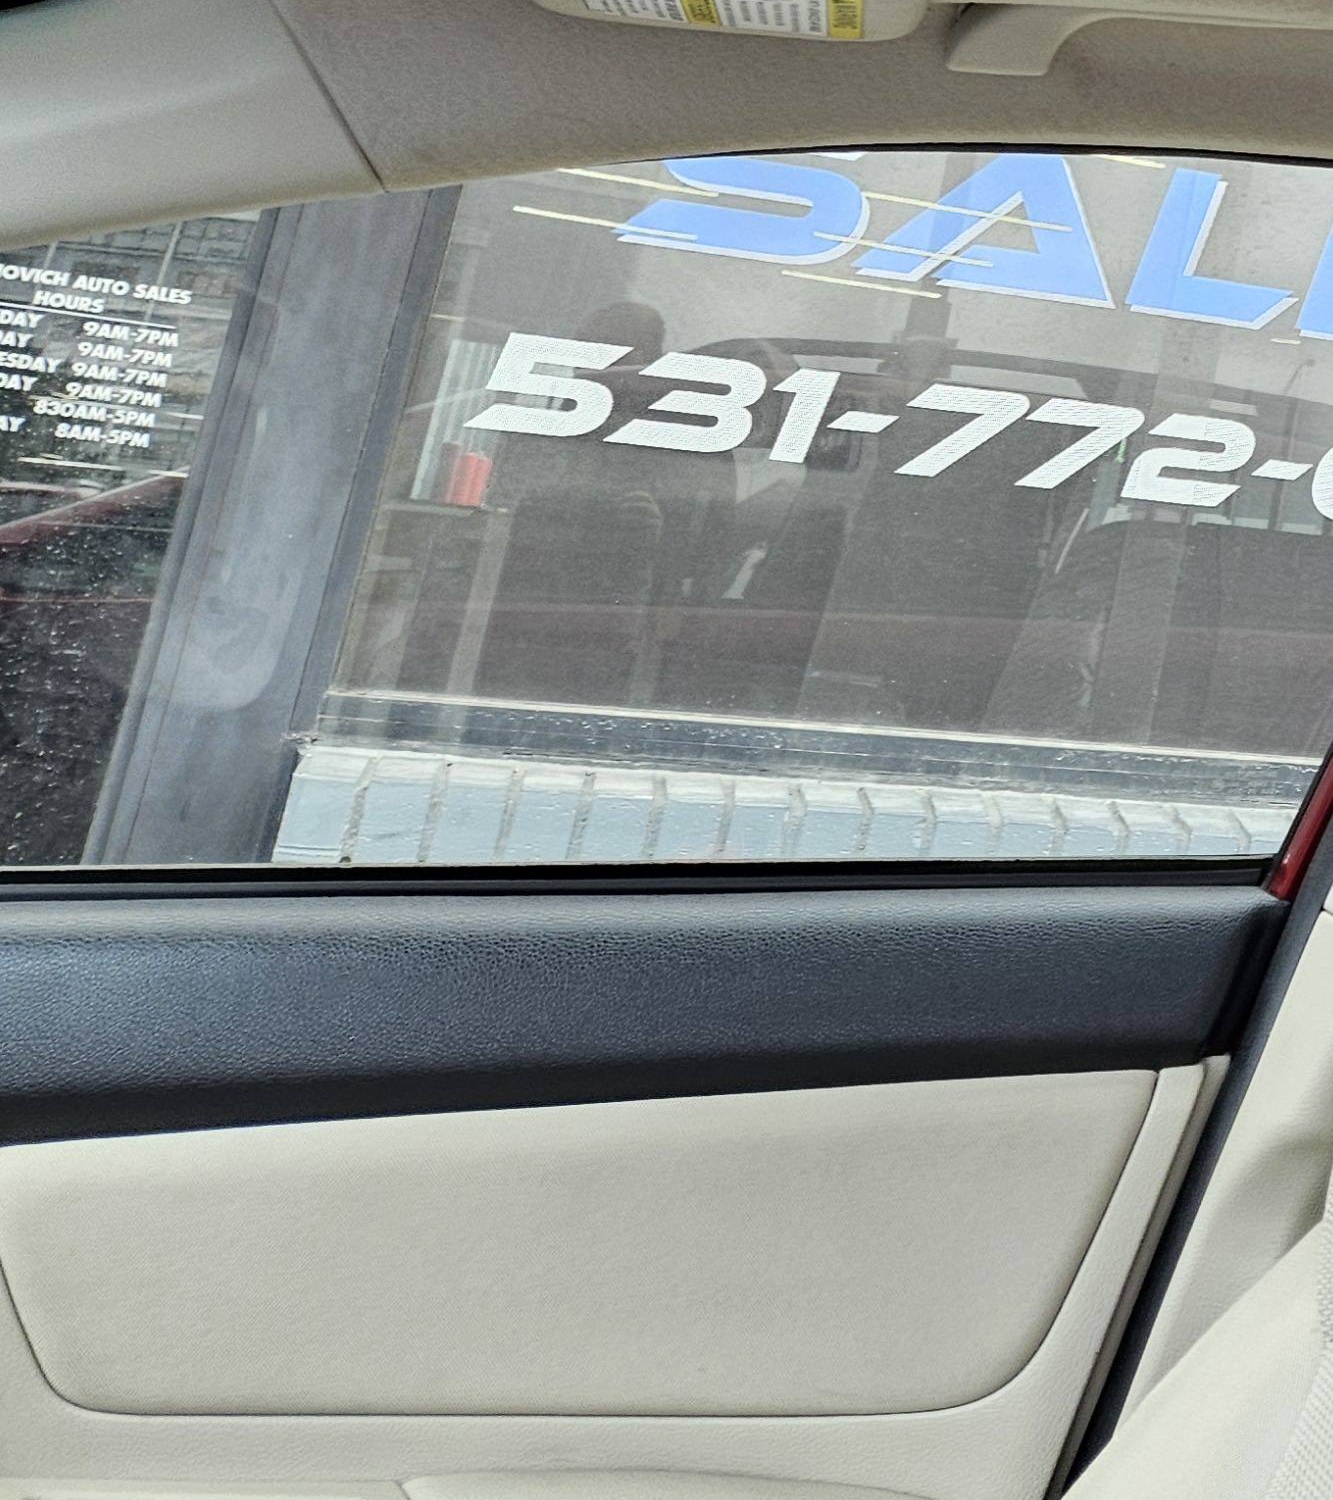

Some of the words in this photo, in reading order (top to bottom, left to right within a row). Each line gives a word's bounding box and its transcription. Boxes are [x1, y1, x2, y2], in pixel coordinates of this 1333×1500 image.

[33, 290, 105, 313] HOURS
[72, 275, 130, 296] AUTO
[133, 284, 193, 305] SALES
[83, 321, 179, 347] 9AM-7PM
[78, 342, 173, 367] 9AM-7PM
[71, 362, 168, 388] 9AM-7PM
[65, 382, 162, 407] 9AM-7PM
[33, 400, 156, 427] 830AM-5PM
[55, 422, 150, 448] 8AM-5PM
